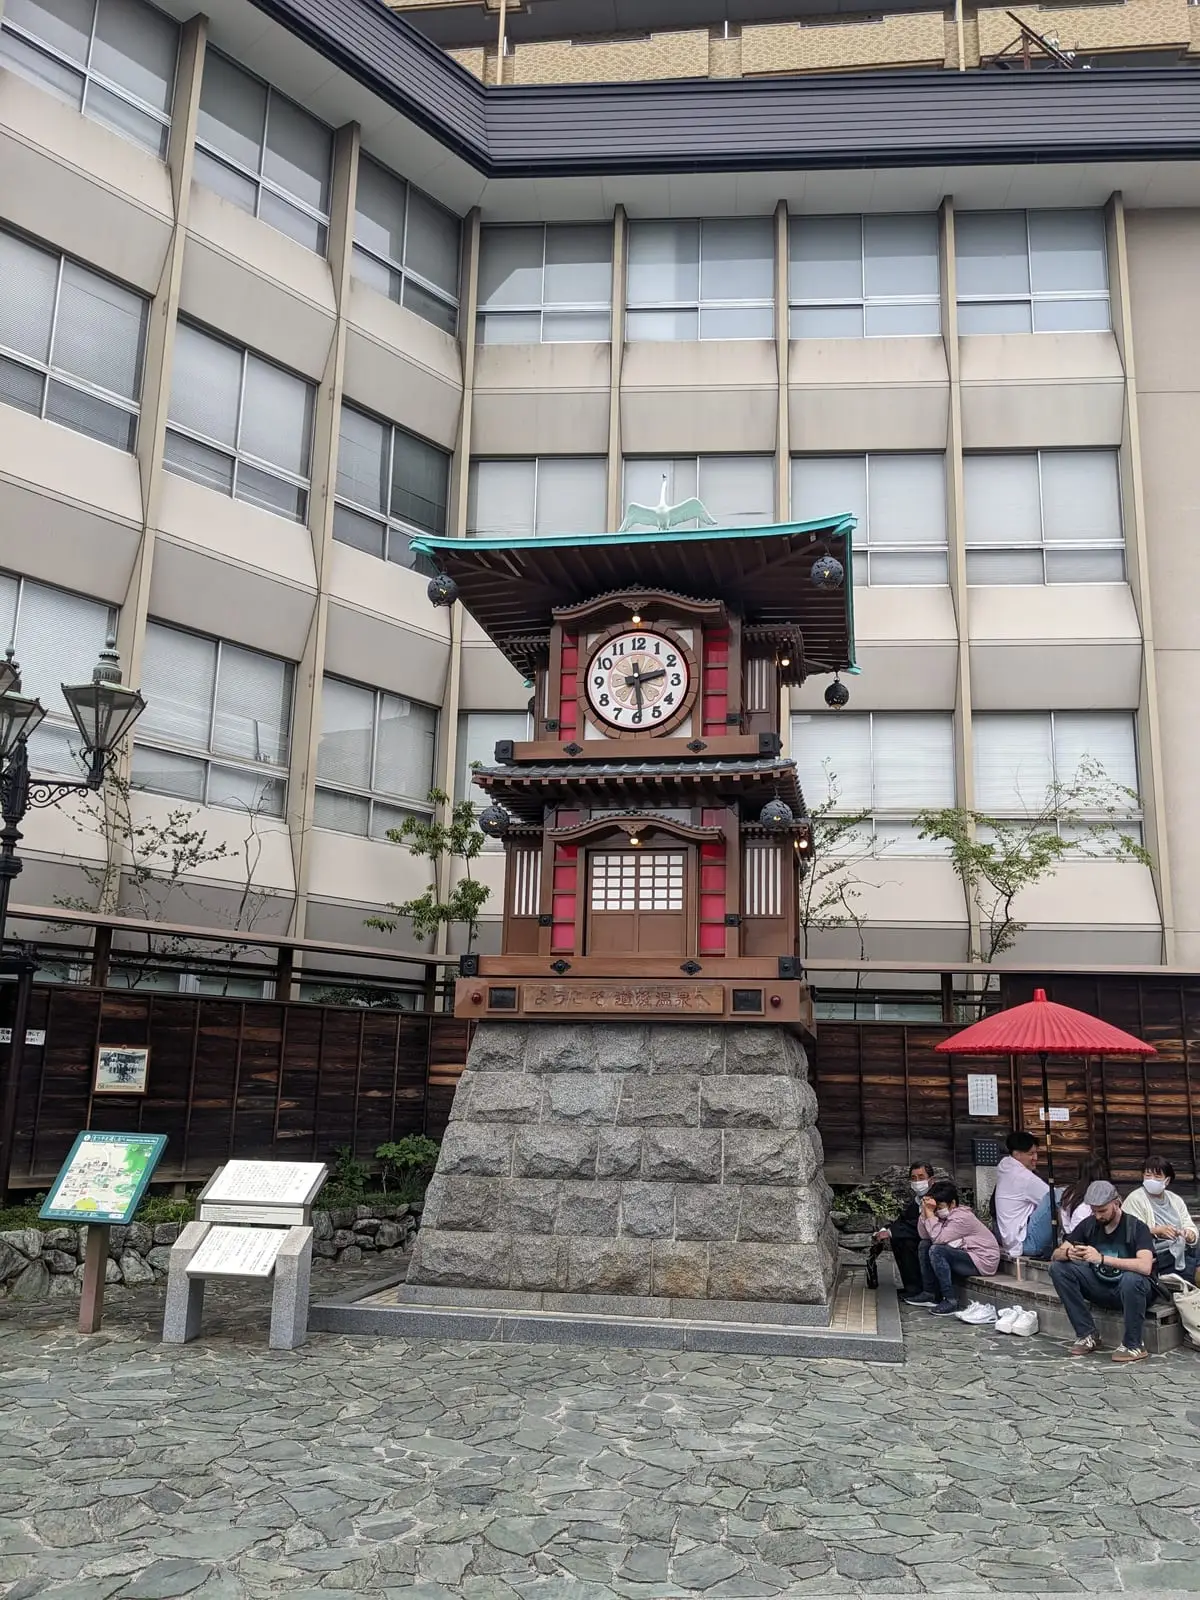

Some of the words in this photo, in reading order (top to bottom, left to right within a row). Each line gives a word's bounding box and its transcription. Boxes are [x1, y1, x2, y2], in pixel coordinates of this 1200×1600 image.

[612, 642, 624, 656] 11
[631, 637, 646, 650] 12
[654, 642, 660, 654] 1
[597, 657, 613, 670] 10
[666, 654, 677, 667] 2
[594, 676, 604, 689] 9
[670, 673, 681, 686] 3
[599, 694, 609, 706] 8
[664, 692, 674, 705] 4
[613, 707, 623, 720] 7
[631, 710, 642, 724] 6
[652, 706, 662, 718] 5
[535, 990, 711, 1008] ようこそ道後温泉へ
